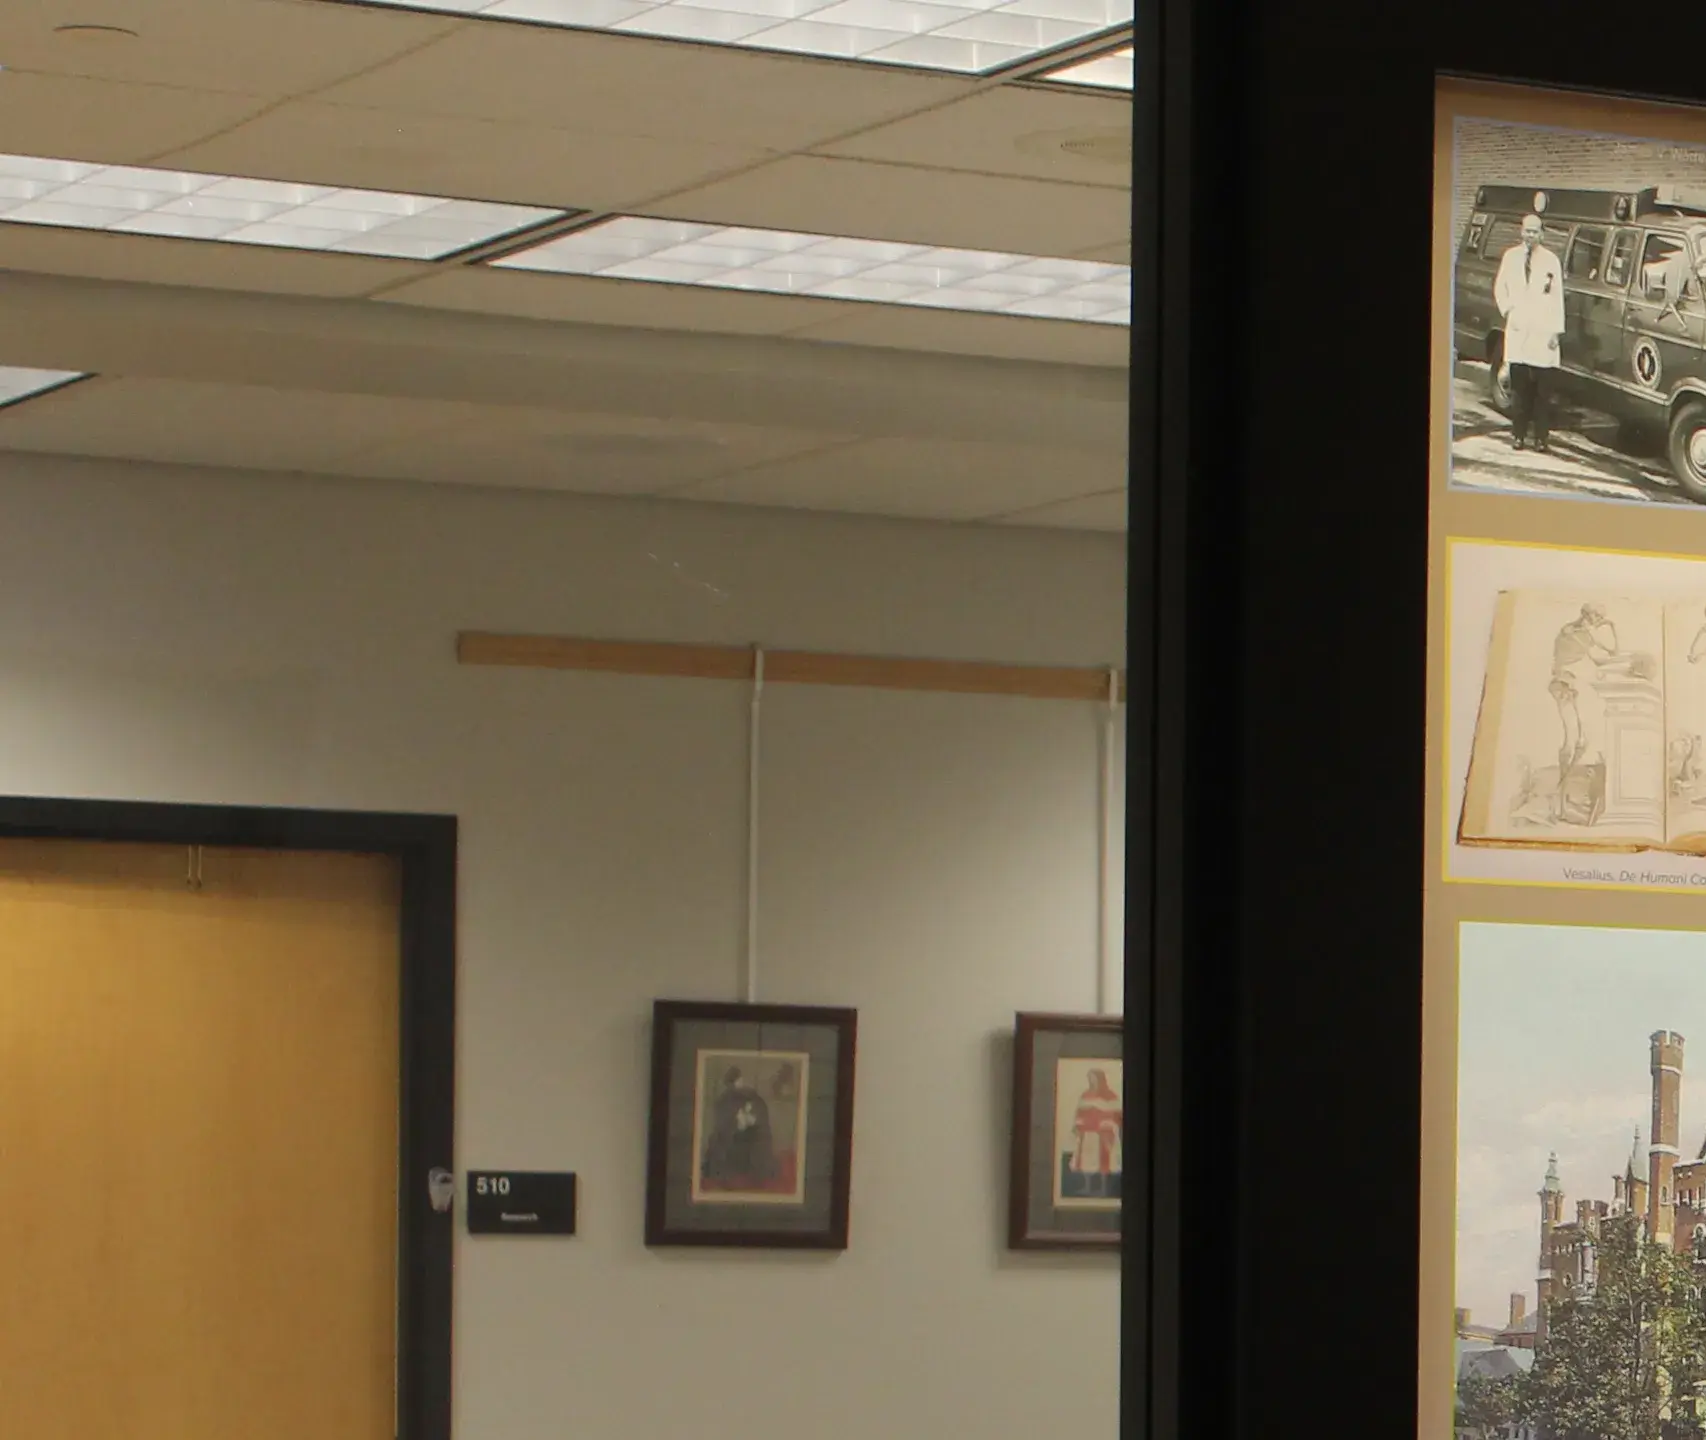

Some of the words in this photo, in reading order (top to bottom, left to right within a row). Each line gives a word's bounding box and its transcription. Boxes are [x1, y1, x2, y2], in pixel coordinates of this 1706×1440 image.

[1619, 870, 1637, 882] De
[1640, 871, 1687, 885] Humani
[475, 1176, 511, 1195] 510
